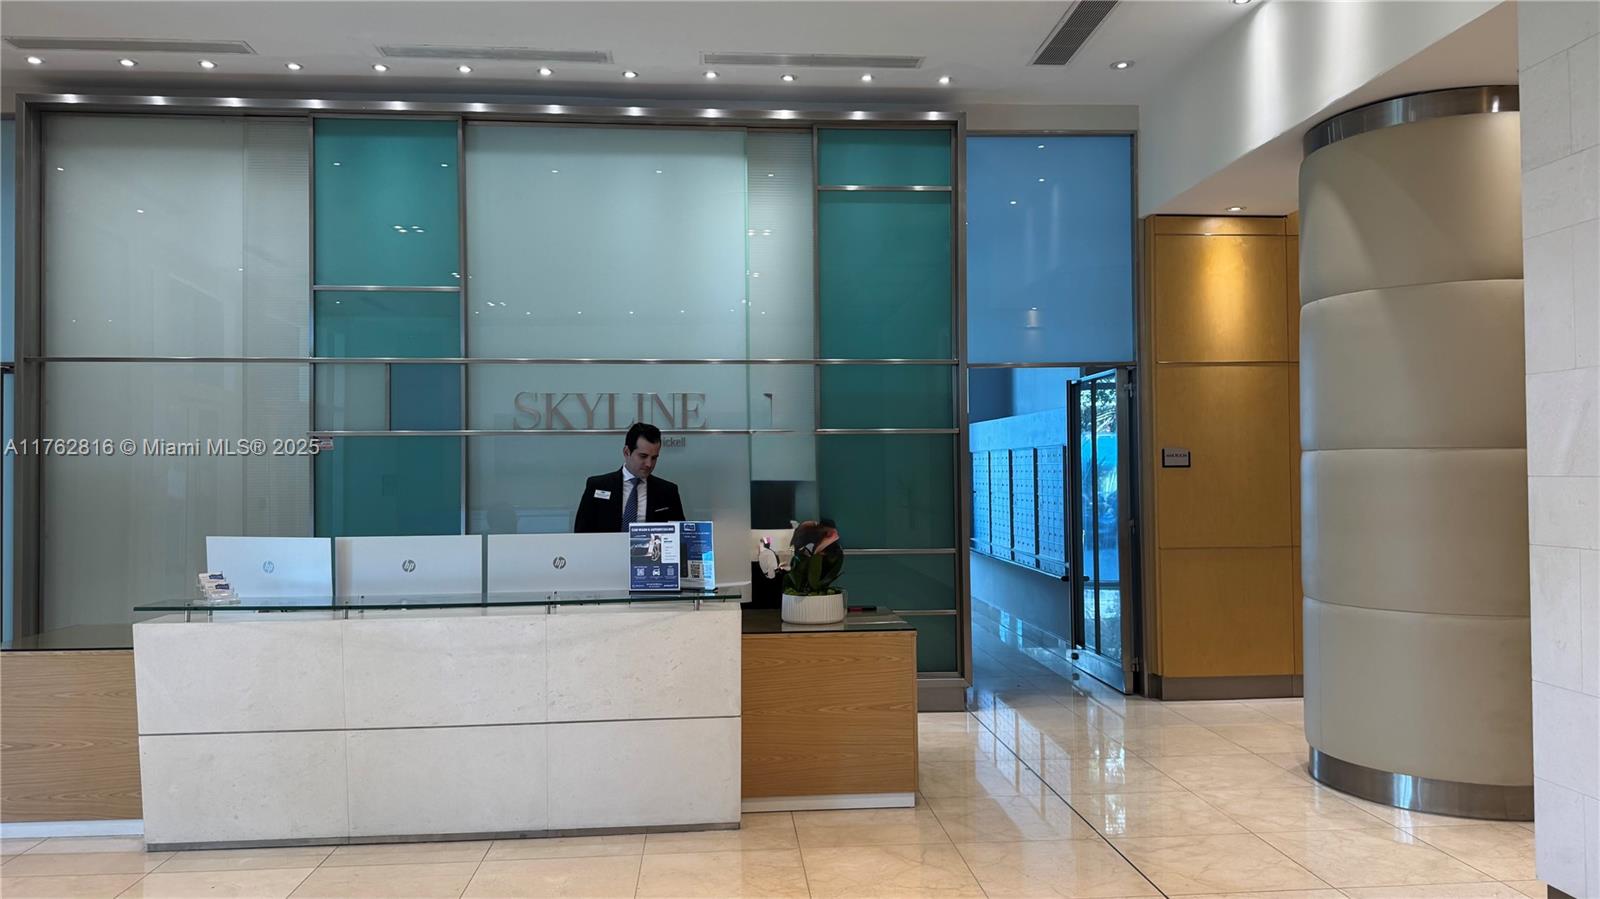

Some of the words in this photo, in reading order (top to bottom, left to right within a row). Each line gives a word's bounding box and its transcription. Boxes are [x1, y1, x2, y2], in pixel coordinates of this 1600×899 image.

[513, 391, 708, 430] SKYLINE
[662, 437, 686, 447] ickell
[263, 561, 275, 574] hp
[402, 559, 416, 573] hp
[553, 556, 567, 570] hp
